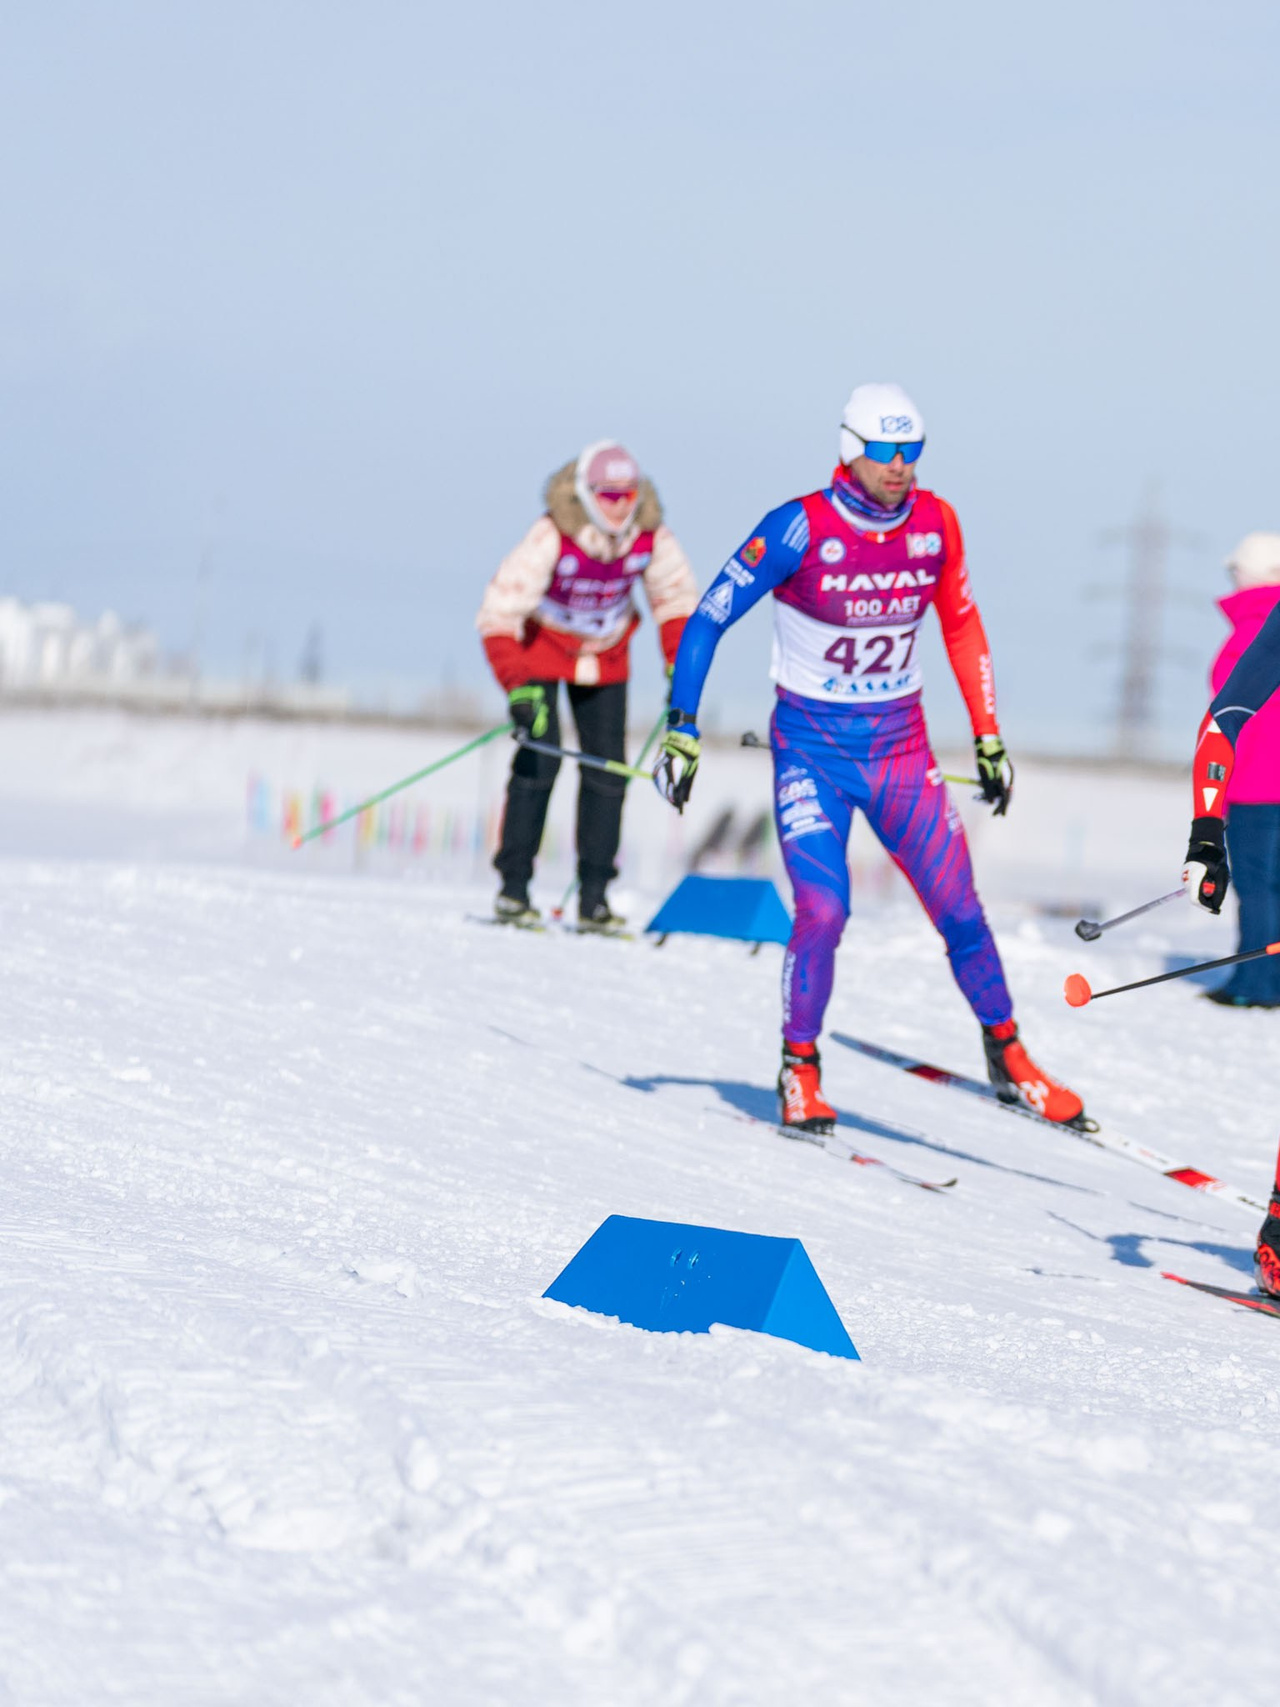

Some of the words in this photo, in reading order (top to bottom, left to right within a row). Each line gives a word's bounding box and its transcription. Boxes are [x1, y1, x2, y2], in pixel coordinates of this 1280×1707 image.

[821, 569, 936, 591] HAVAL
[844, 598, 882, 617] 100
[887, 595, 921, 615] ЛЕТ
[824, 627, 917, 676] 427
